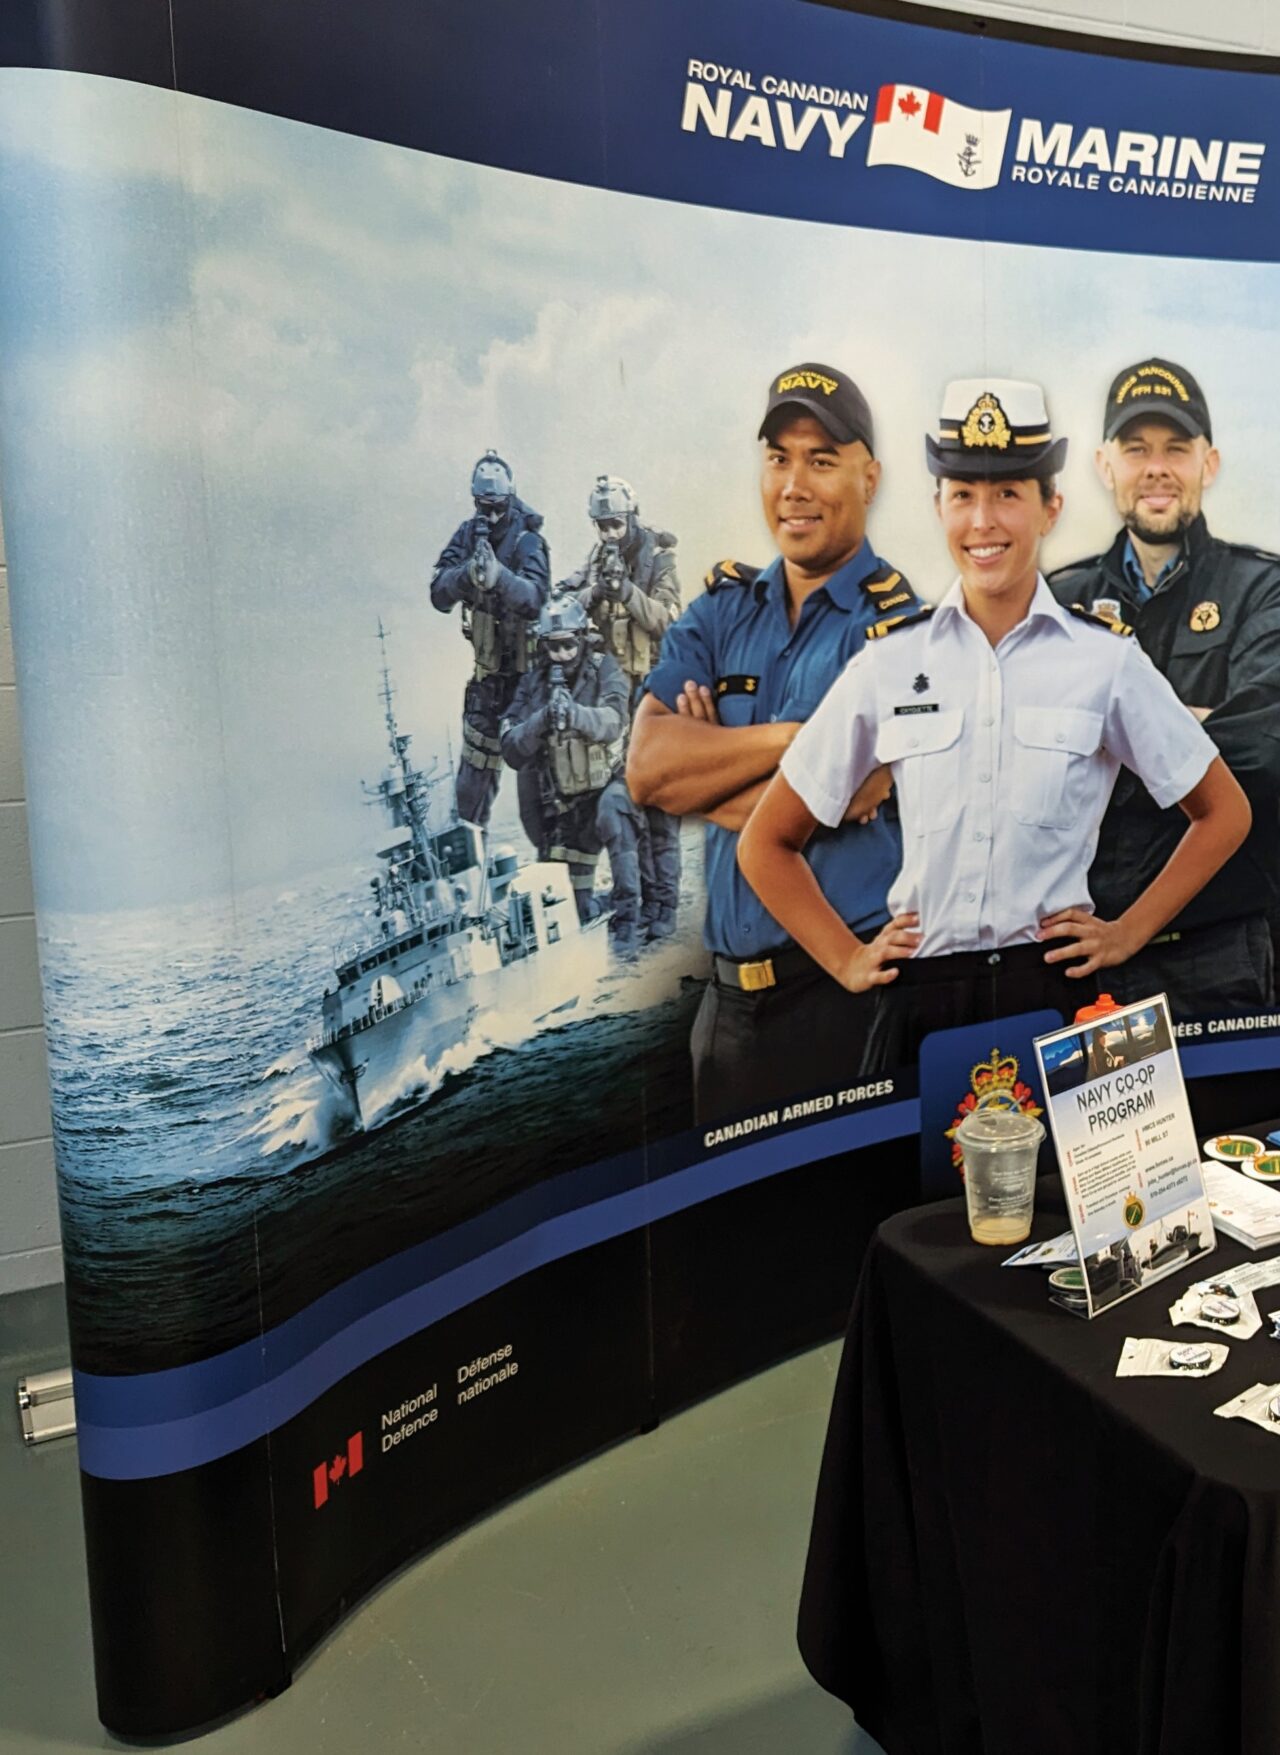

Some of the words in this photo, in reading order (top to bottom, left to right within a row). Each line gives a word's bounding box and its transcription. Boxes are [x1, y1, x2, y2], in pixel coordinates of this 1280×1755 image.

[687, 58, 756, 91] ROYAL
[761, 75, 869, 112] CANADIAN
[681, 81, 866, 159] NAVY
[1015, 118, 1266, 185] MARINE
[1011, 165, 1101, 190] ROYALE
[1108, 176, 1256, 203] CANADIENNE
[777, 376, 839, 396] NAVY
[704, 1110, 779, 1148] CANADIAN
[781, 1095, 834, 1122] ARMED
[836, 1079, 895, 1107] FORCES
[1076, 1081, 1112, 1112] NAVY
[1115, 1064, 1155, 1094] CO-OP
[1088, 1089, 1156, 1134] PROGRAM
[1156, 1112, 1175, 1125] HUNTER
[381, 1383, 438, 1431] National
[457, 1344, 513, 1384] Défense
[382, 1408, 438, 1453] Defence
[457, 1362, 519, 1405] nationale
